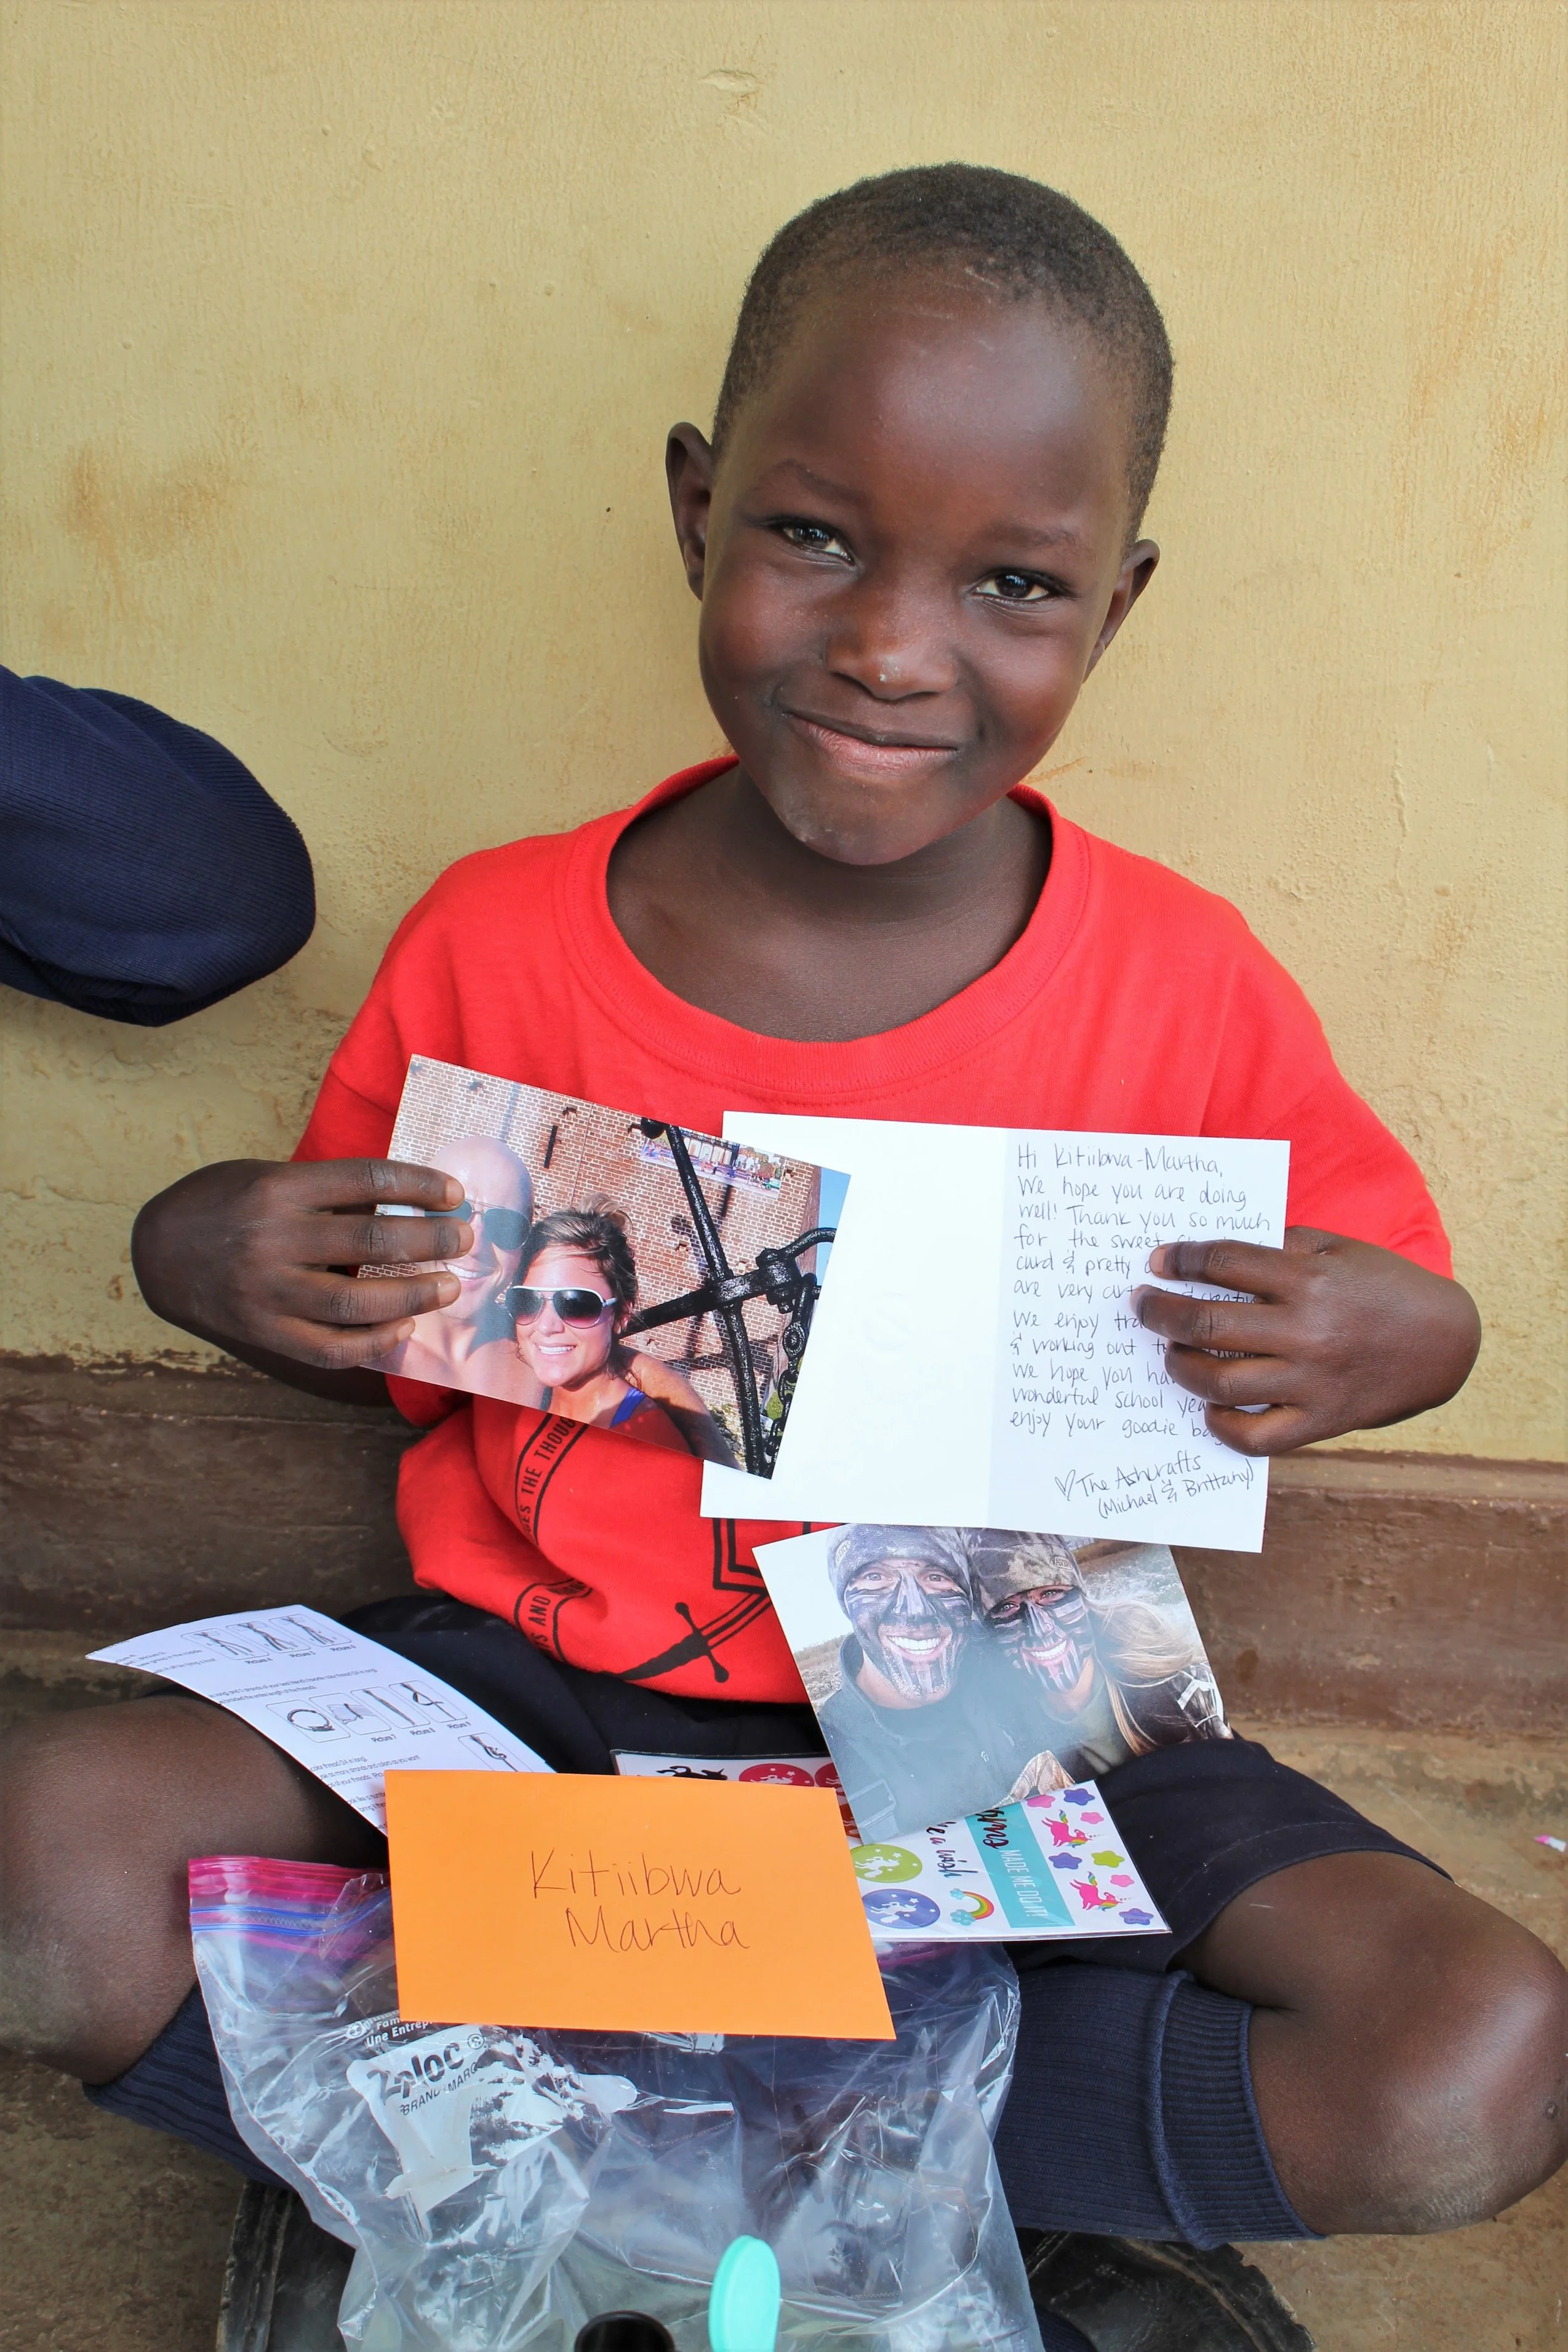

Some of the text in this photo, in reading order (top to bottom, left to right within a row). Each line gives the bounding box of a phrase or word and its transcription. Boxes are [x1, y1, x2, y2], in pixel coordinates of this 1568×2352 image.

[1018, 1142, 1037, 1169] Hi
[1017, 1173, 1247, 1211] We hope you are doing
[1065, 1204, 1131, 1227] Thank
[1142, 1210, 1176, 1234] you
[1189, 1212, 1207, 1228] so
[1216, 1210, 1271, 1232] much
[1014, 1223, 1049, 1249] for
[1069, 1227, 1099, 1249] the
[1110, 1231, 1165, 1249] sweet
[1062, 1248, 1076, 1276] &
[1085, 1254, 1131, 1279] pretty
[1014, 1279, 1046, 1298] are
[1057, 1281, 1093, 1305] very
[1014, 1310, 1041, 1328] We
[1054, 1312, 1099, 1338] enjoy
[1010, 1333, 1023, 1355] &
[1032, 1340, 1094, 1359] working
[1106, 1340, 1138, 1357] out
[1050, 1359, 1089, 1387] hope
[1102, 1365, 1133, 1391] you
[1012, 1385, 1207, 1418] wonderful school yea
[1009, 1409, 1051, 1437] enjoy
[1065, 1412, 1106, 1437] your
[1122, 1418, 1179, 1438] goodie
[521, 1466, 542, 1495] THE
[534, 1417, 576, 1461] THOUG
[1075, 1450, 1202, 1497] The Ashcrafts
[1098, 1458, 1254, 1518] (Michael & Brittany)
[528, 1596, 551, 1627] AND
[929, 1836, 946, 1845] a
[531, 1847, 741, 1899] Kitiibwa
[936, 1849, 978, 1878] wish
[999, 1849, 1029, 1873] MADE
[1010, 1875, 1036, 1888] ME
[1017, 1890, 1042, 1904] DO
[1023, 1905, 1049, 1917] IT!
[566, 1905, 750, 1953] Martha
[366, 2021, 434, 2048] Une Entrep
